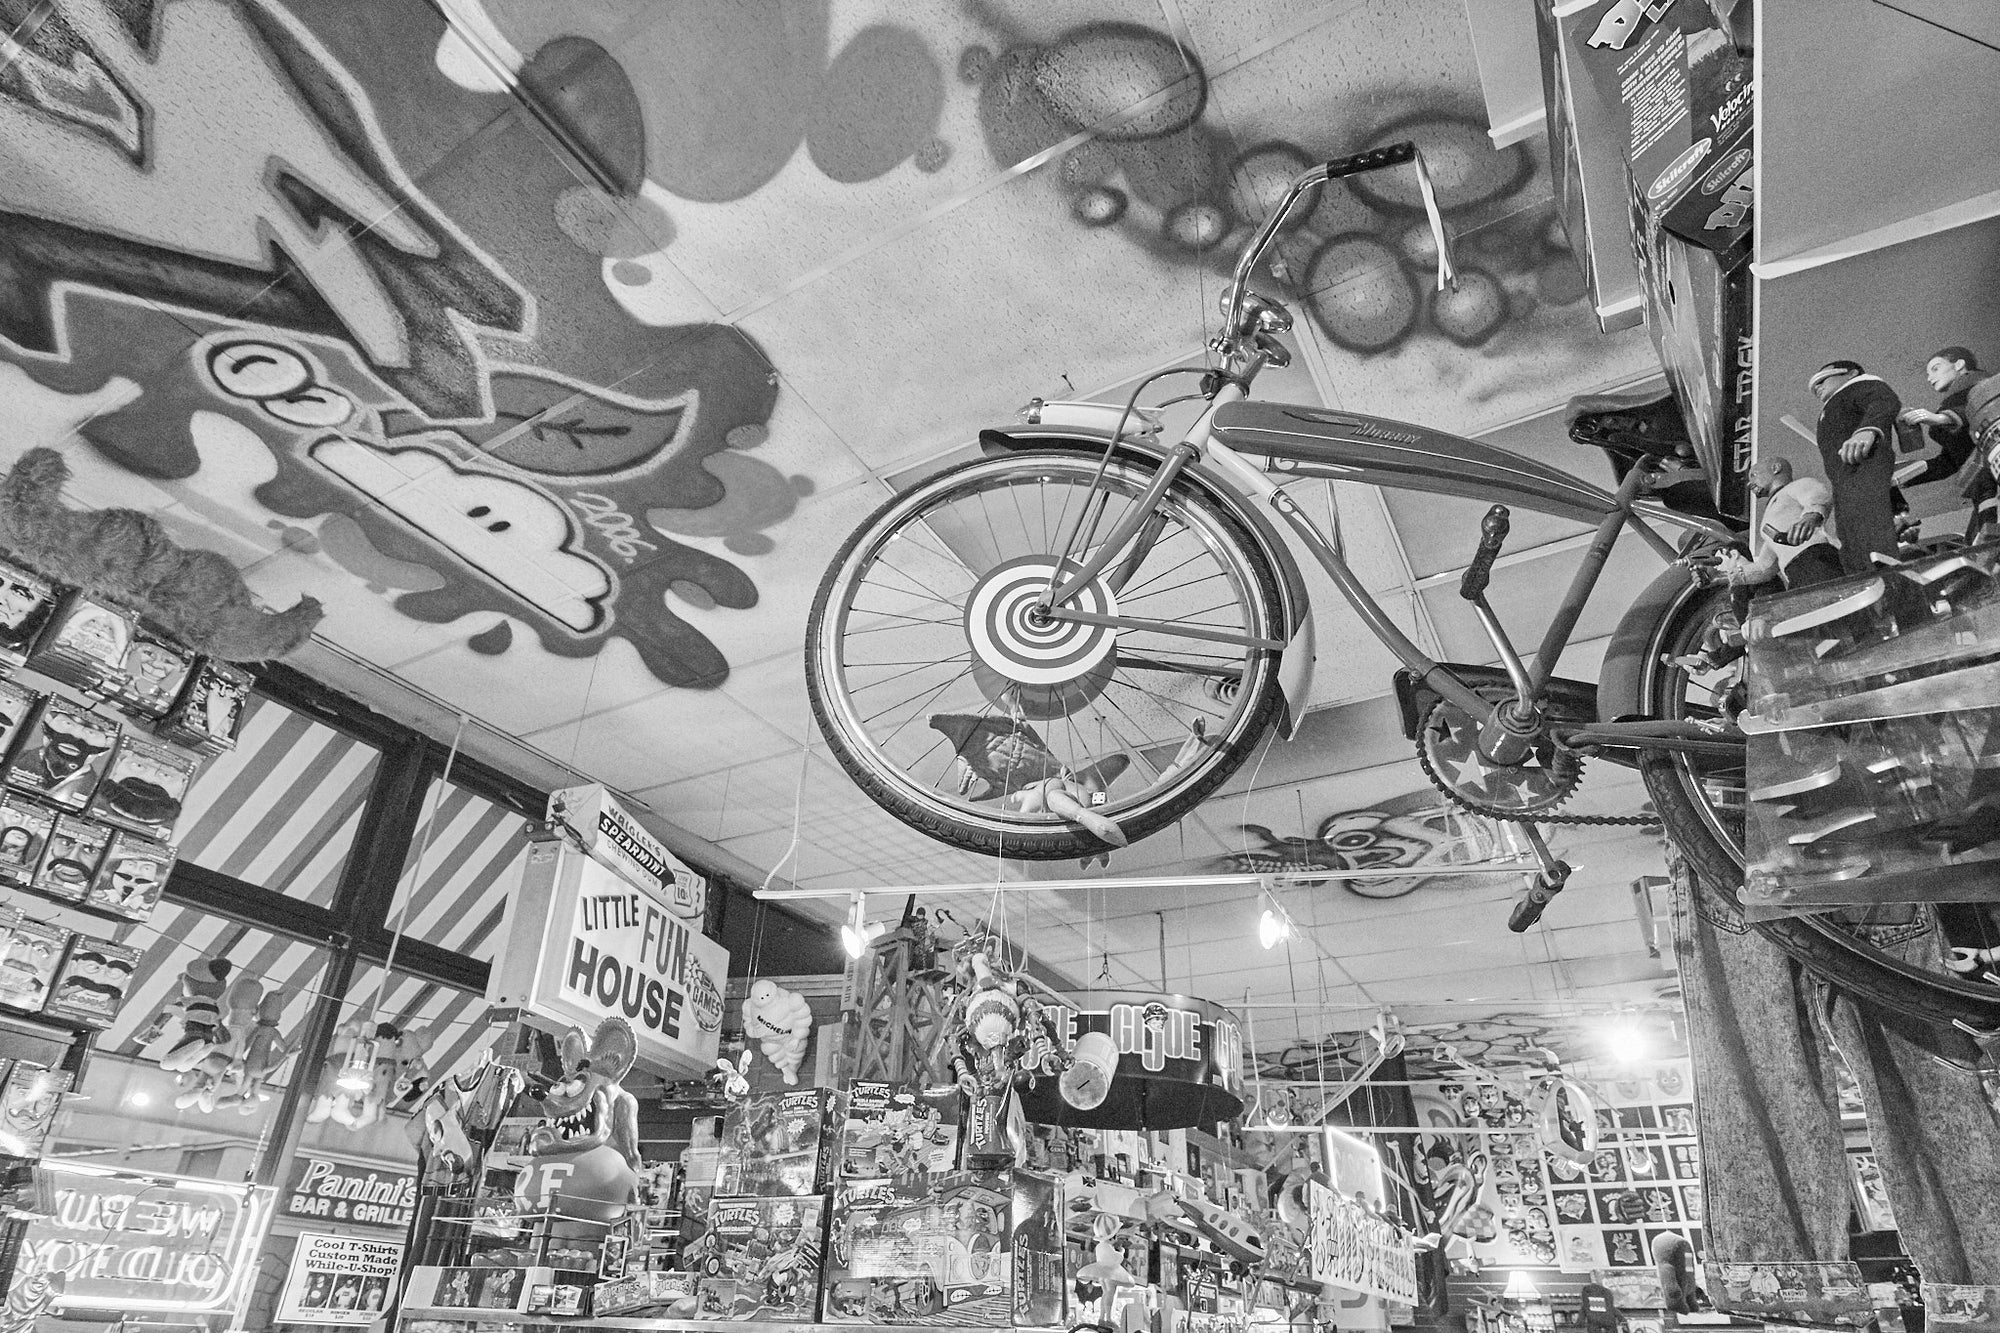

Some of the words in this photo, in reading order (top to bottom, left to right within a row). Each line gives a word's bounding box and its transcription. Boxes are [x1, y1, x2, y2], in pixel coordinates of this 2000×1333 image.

[1655, 145, 1707, 194] Skilcraft
[1706, 153, 1748, 192] Skilcraft
[600, 818, 667, 876] SPEARMINT
[608, 805, 662, 857] WRIGLEY'S
[607, 840, 641, 872] CHEWING
[579, 894, 640, 931] LITTLE
[640, 905, 690, 986] FUN
[568, 937, 684, 1040] HOUSE
[692, 986, 721, 1018] GAMES
[757, 1015, 792, 1035] MICHELIN
[778, 1095, 819, 1111] TURTLES
[850, 1086, 891, 1099] TURTLES
[974, 1098, 988, 1150] TURTLES
[295, 1159, 417, 1208] Panini's
[839, 1186, 896, 1208] TURTLES
[289, 1194, 331, 1216] BAR
[333, 1200, 348, 1219] &
[352, 1203, 414, 1227] GRILLE
[710, 1208, 760, 1228] TURTLES
[308, 1248, 360, 1262] Custom
[362, 1253, 398, 1266] Made
[314, 1239, 345, 1251] Cool
[348, 1242, 399, 1256] T-Shirts
[305, 1259, 398, 1277] While-U-Shop!
